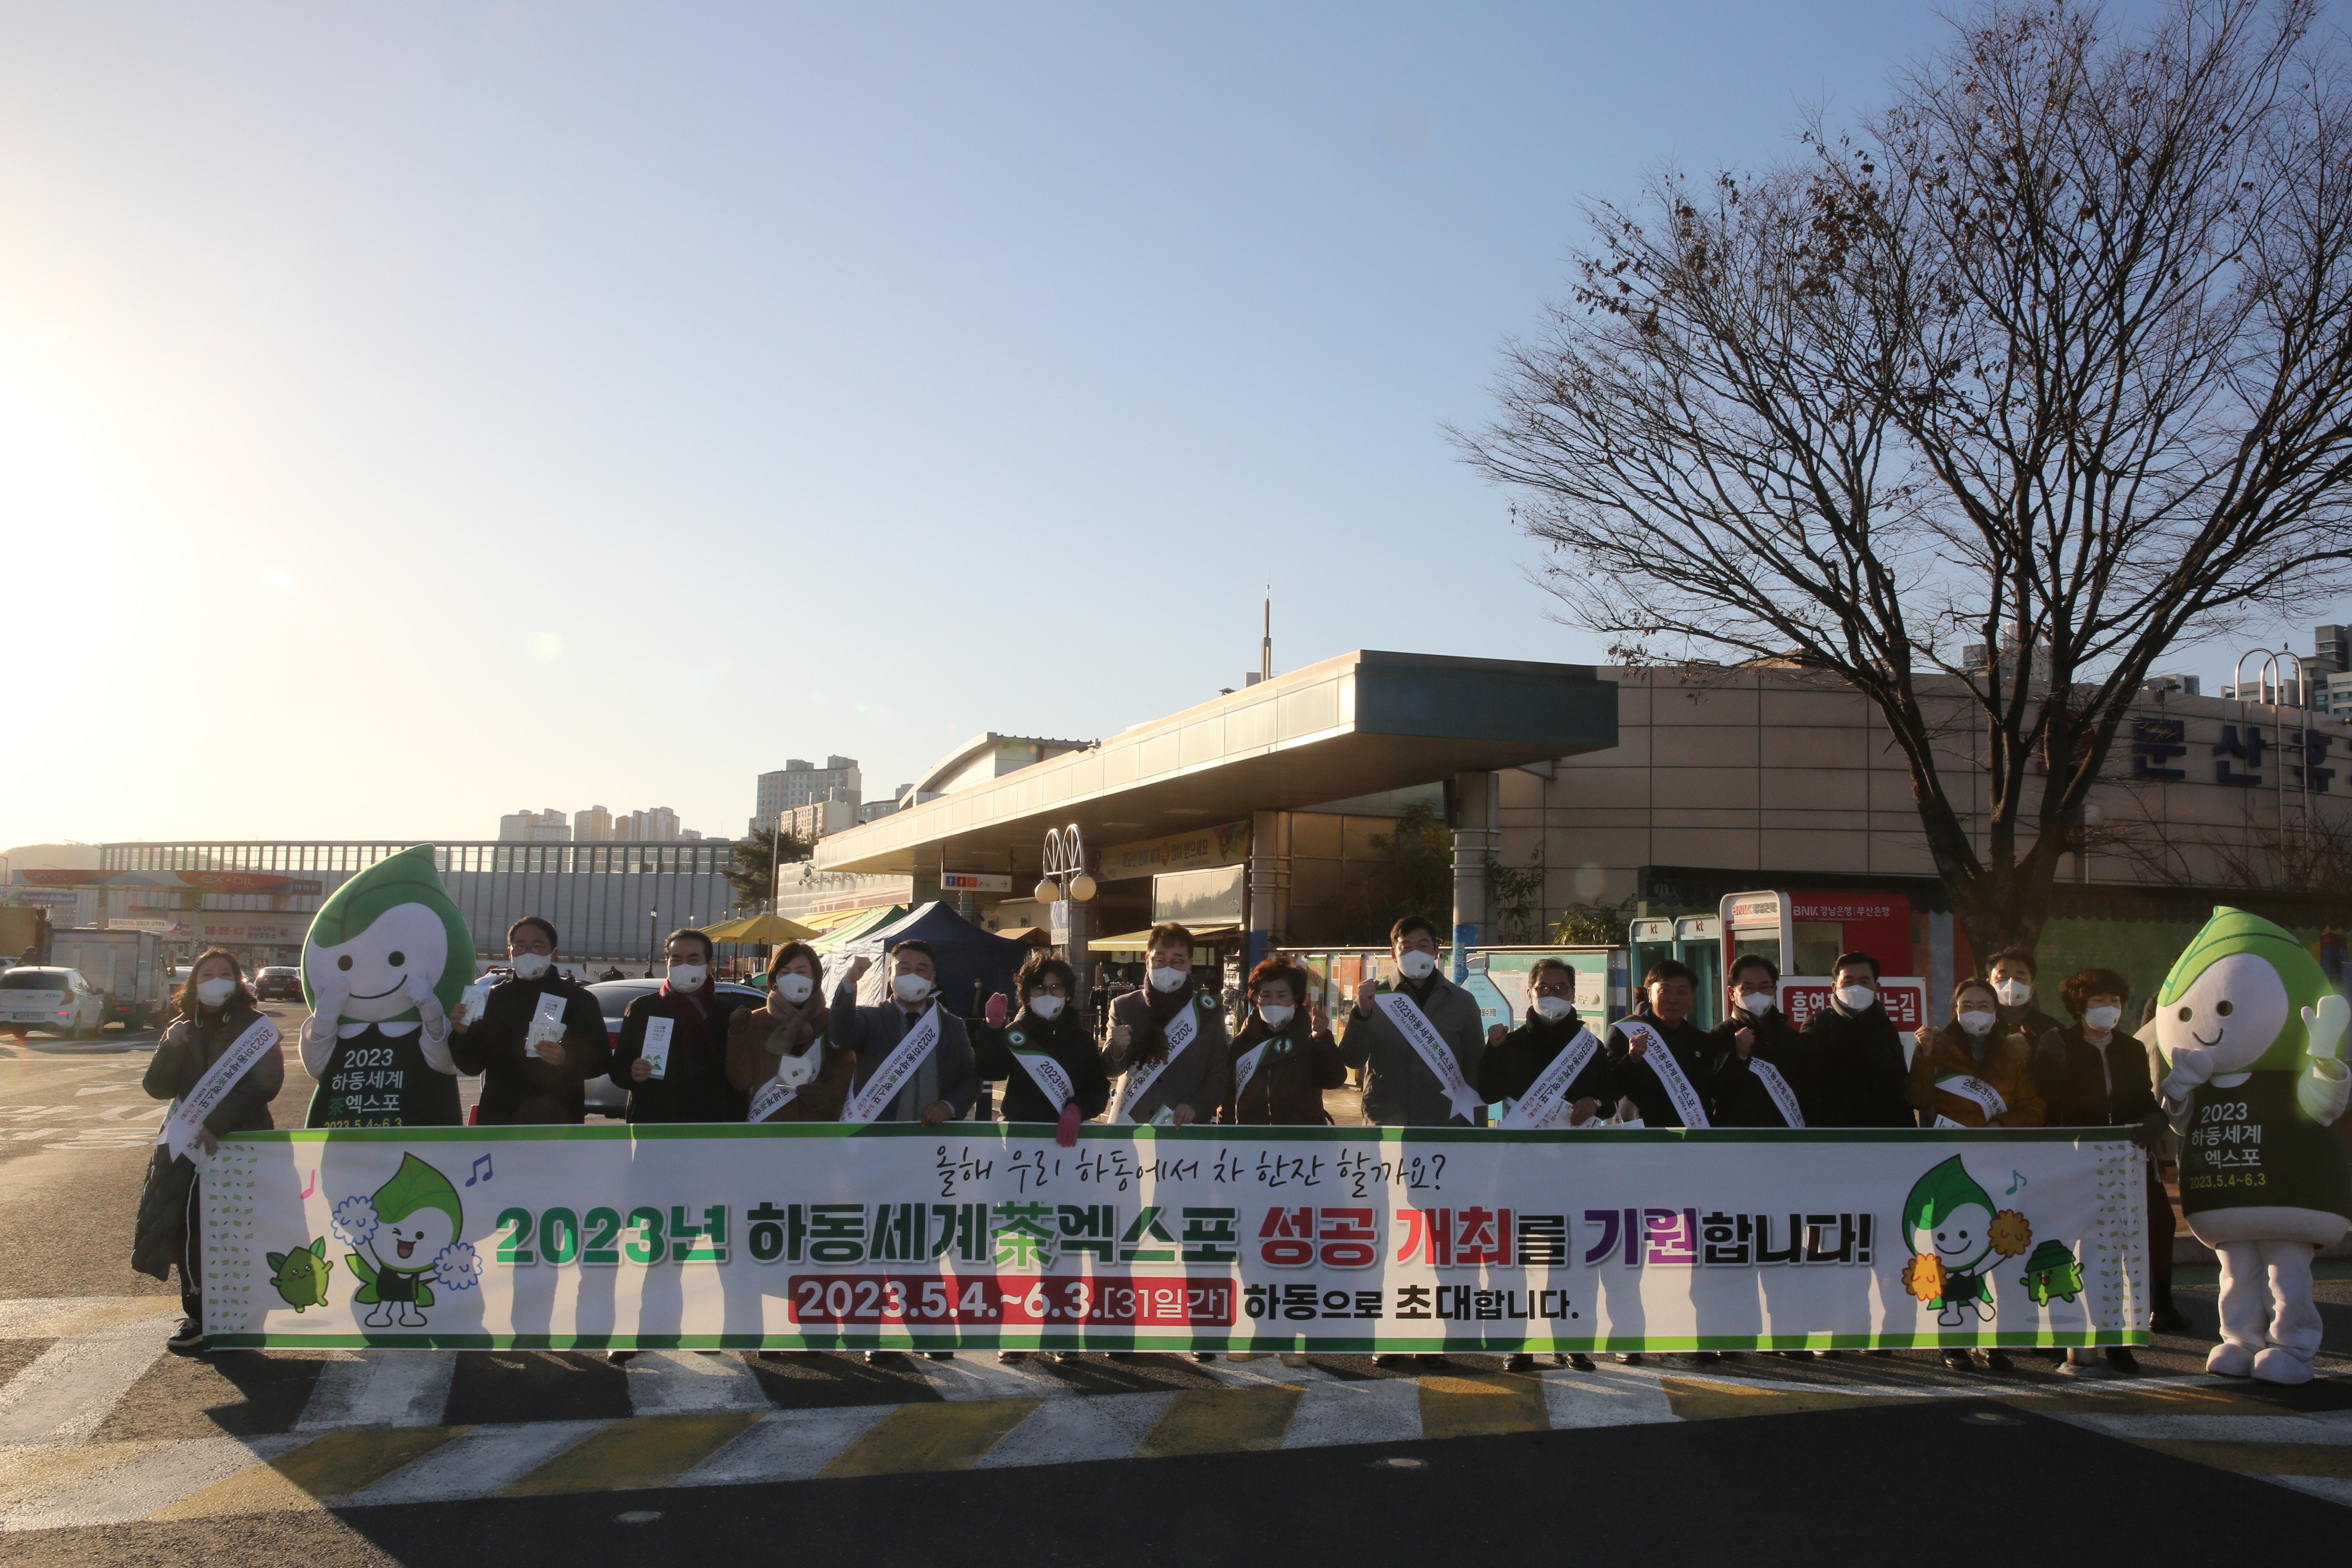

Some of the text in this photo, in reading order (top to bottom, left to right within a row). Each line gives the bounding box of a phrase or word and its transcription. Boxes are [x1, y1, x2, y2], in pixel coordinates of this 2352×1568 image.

[2132, 717, 2352, 793] 문산휴
[1184, 838, 1208, 859] 받으세요
[21, 893, 48, 901] Hyundai
[1732, 905, 1751, 915] BNK
[1793, 906, 1890, 917] BNK 경남은행 부산은행
[1650, 924, 1658, 934] kt
[1696, 920, 1704, 932] kt
[1456, 942, 1466, 978] 행복한
[1480, 1009, 1497, 1017] 용수거함
[1792, 991, 1915, 1022] 흡연 는길
[250, 1026, 265, 1040] WORLD
[917, 1024, 930, 1038] WORLD
[1171, 1019, 1185, 1033] WORLD
[1393, 997, 1454, 1073] 2023하동세계茶엑스포
[242, 1039, 251, 1047] TEA
[1389, 1003, 1400, 1018] WORLD
[1405, 1024, 1415, 1035] EXPO
[1413, 1034, 1423, 1044] 2023
[1422, 1043, 1437, 1063] HADONG,
[1437, 1062, 1448, 1077] KOREA
[232, 1046, 243, 1058] EXPO
[343, 1048, 394, 1068] 2023
[901, 1045, 911, 1056] EXPO
[1568, 1049, 1577, 1059] EXPO
[199, 1029, 274, 1109] 2023하동세계茶엑스포
[223, 1057, 232, 1068] 2023
[871, 1028, 935, 1105] 2023하동세계茶엑스포
[893, 1055, 903, 1065] 2023
[1561, 1056, 1570, 1067] 2023
[1637, 1026, 1695, 1109] 223하동세계茶엑스포
[205, 1067, 224, 1087] HADONG,
[878, 1064, 895, 1083] HADONG,
[1539, 1035, 1595, 1104] 2023하동세계茶엑스포
[1545, 1066, 1562, 1083] HADONG,
[332, 1070, 404, 1091] 하동세계
[1035, 1067, 1049, 1083] WORLD
[1054, 1091, 1063, 1103] EXPO
[1650, 1054, 1660, 1067] EXPO
[1658, 1064, 1667, 1074] 2023
[1665, 1074, 1678, 1096] HADONG,
[1677, 1095, 1688, 1111] KOREA
[1765, 1074, 1773, 1085] EXPO
[193, 1089, 207, 1103] KOREA
[866, 1083, 879, 1098] KOREA
[1533, 1082, 1547, 1097] KOREA
[1751, 1058, 1802, 1123] 23하동세계茶엑스포
[1961, 1085, 1979, 1096] WORLD
[1979, 1094, 1987, 1102] TEA
[328, 1094, 400, 1116] 茶엑스포
[2201, 1102, 2248, 1124] 2023
[2192, 1125, 2262, 1147] 하동세계
[936, 1145, 1447, 1198] 올해 우리 하동에서 차 한잔 할까요?
[2189, 1173, 2266, 1189] 2023.5.4~6.3
[496, 1200, 1872, 1268] 2023년 하동세계茶엑스포 성공 개최를 기원합니다!
[1244, 1284, 1383, 1321] 하동으로
[1396, 1285, 1579, 1321] 초대합니다.
